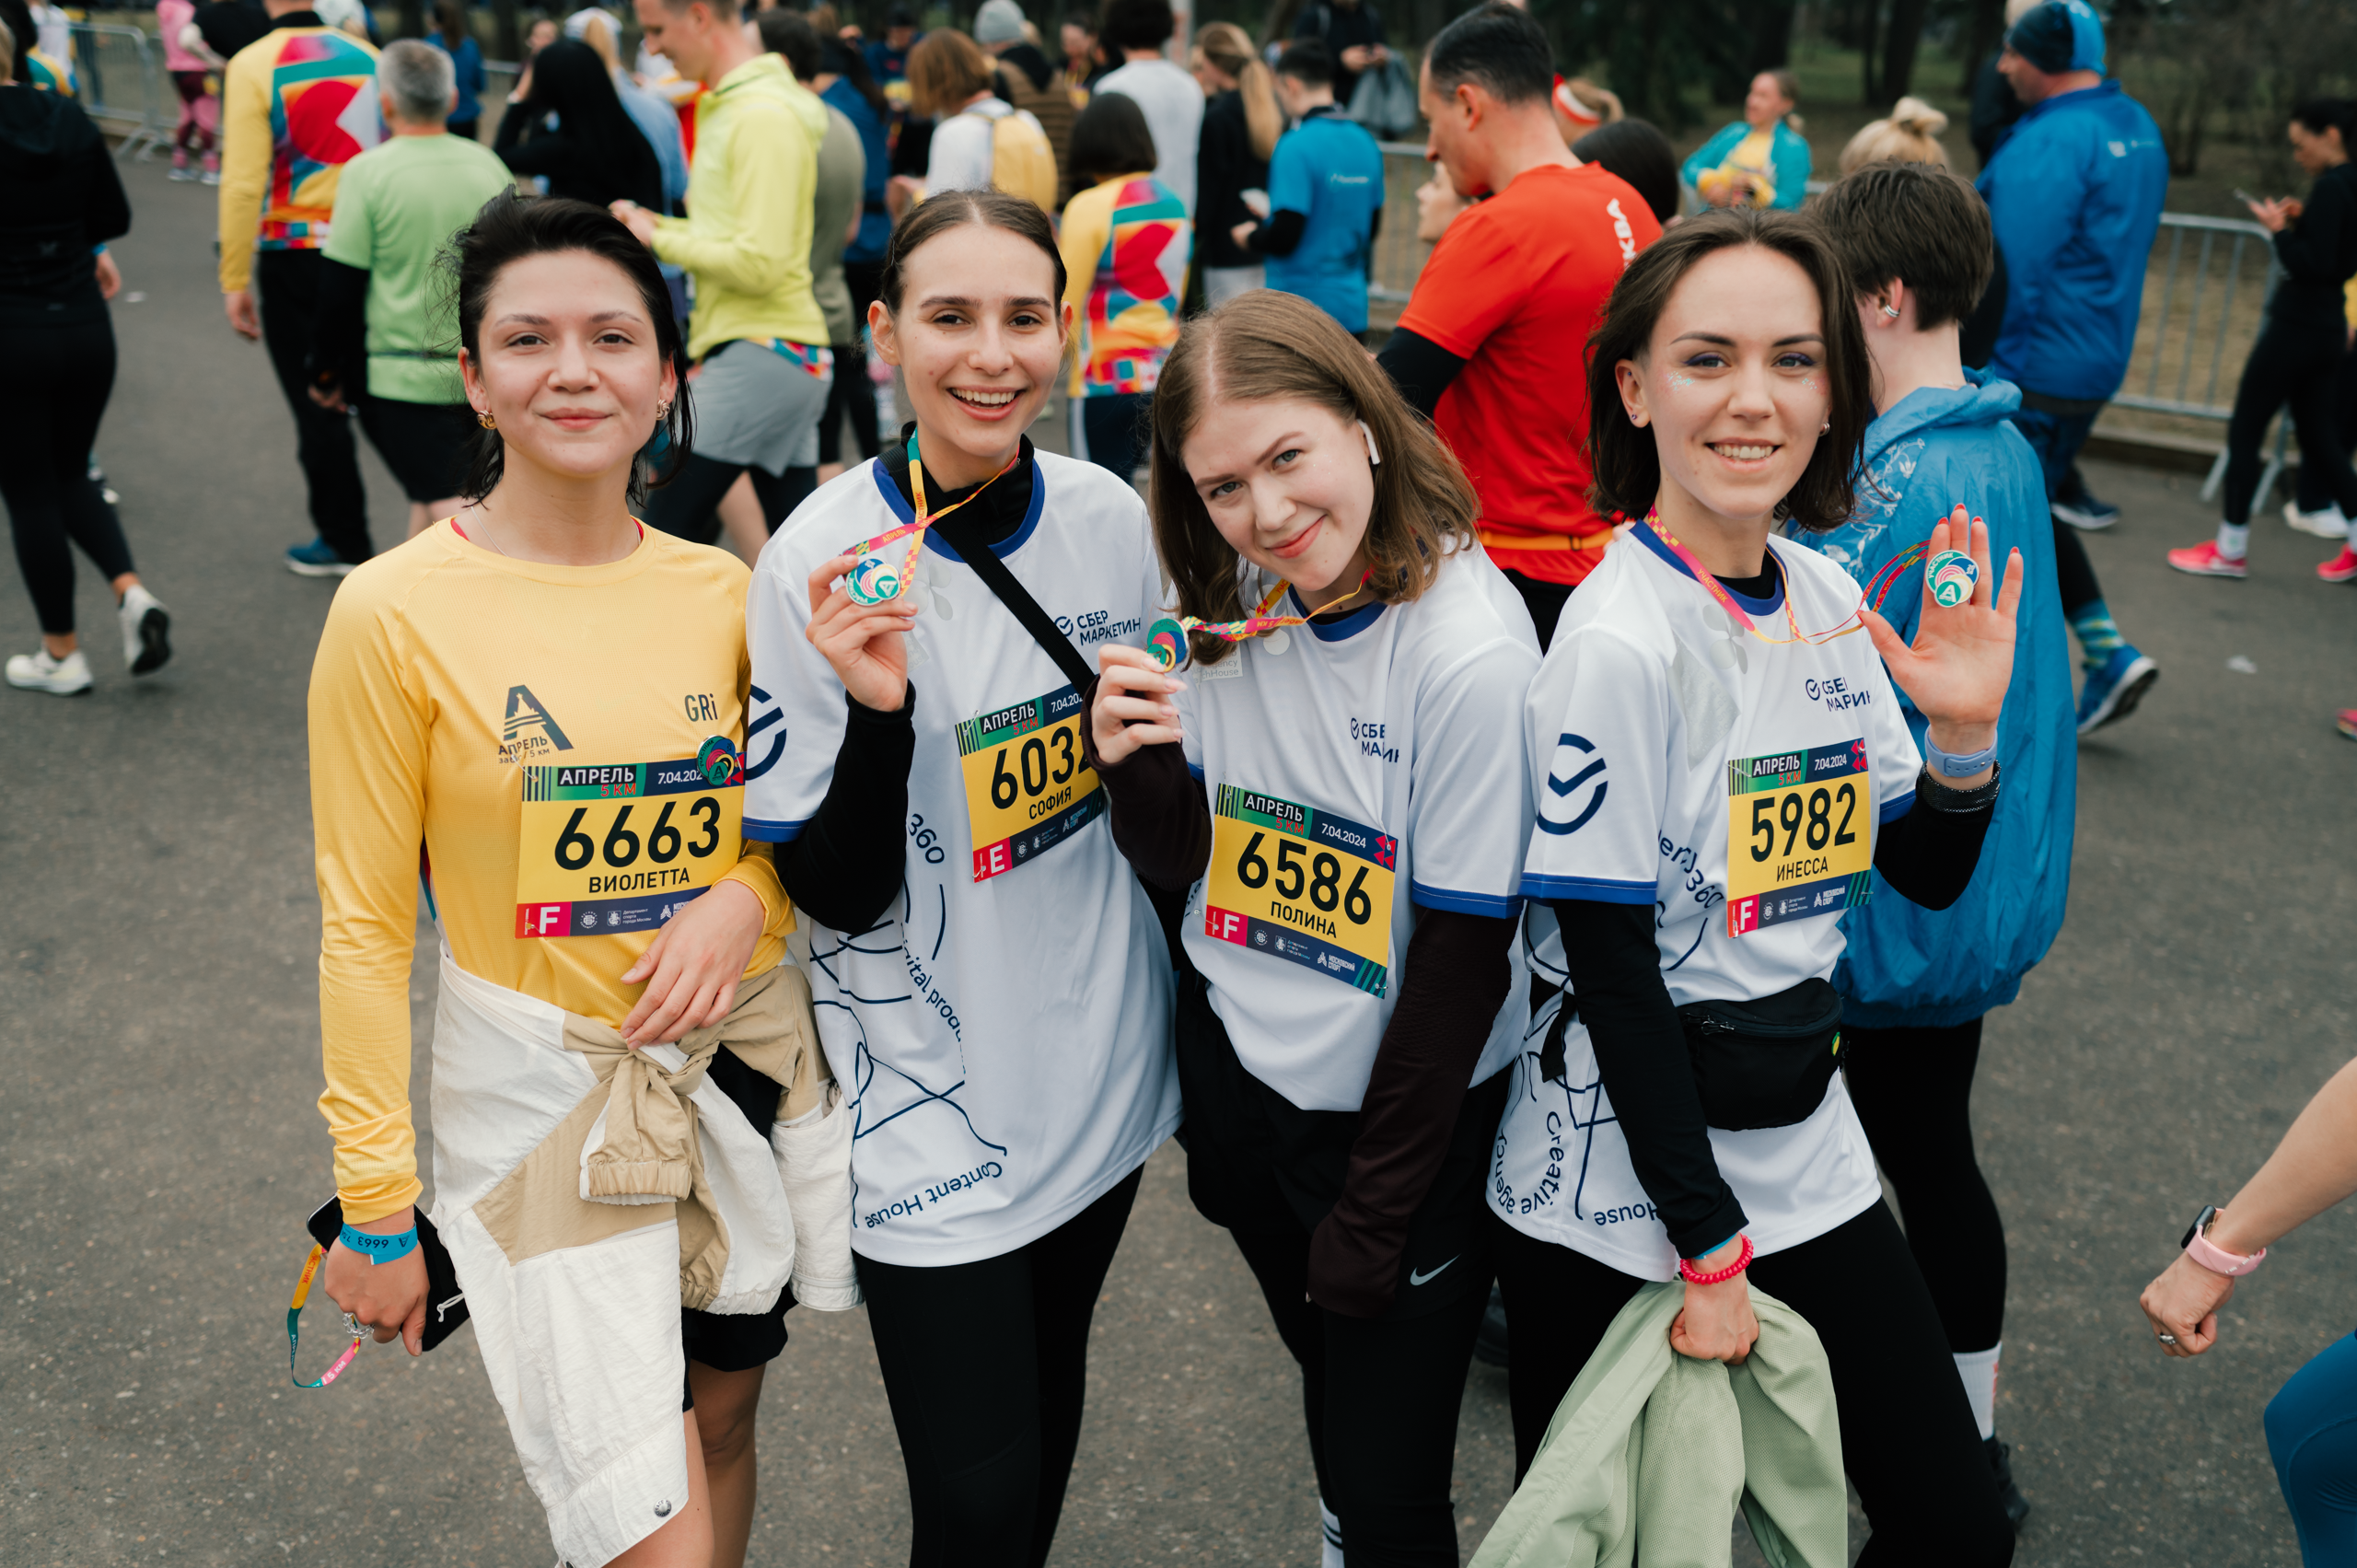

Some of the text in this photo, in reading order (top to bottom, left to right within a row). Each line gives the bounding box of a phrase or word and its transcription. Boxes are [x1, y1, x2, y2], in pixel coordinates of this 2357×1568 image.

[915, 492, 924, 522] АСТНИК
[882, 528, 906, 543] АПРЕЛЬ
[1697, 568, 1728, 603] УЧАСТНИК
[1076, 610, 1109, 629] СБЕР
[1821, 677, 1848, 694] СБЕ
[983, 703, 1036, 733] АПРЕЛЬ
[1013, 716, 1039, 736] 5 КМ
[1361, 723, 1385, 738] СБЕ
[498, 736, 548, 755] АПРЕЛЬ
[529, 749, 535, 758] 5
[538, 748, 551, 756] км
[1753, 755, 1801, 776] АПРЕЛЬ
[1814, 753, 1848, 772] 7.04.2024
[560, 768, 634, 785] АПРЕЛЬ
[657, 769, 703, 784] 7.04.202
[1778, 771, 1802, 785] 5 КМ
[600, 783, 637, 797] 5 КМ
[1028, 785, 1072, 819] СОФИЯ
[1245, 794, 1303, 822] АПРЕЛЬ
[554, 796, 721, 871] 6663
[1275, 817, 1305, 836] 5 КМ
[1321, 823, 1367, 849] 7.04.2024
[1750, 783, 1856, 863] 5982
[989, 844, 1005, 874] E
[1776, 856, 1829, 883] ИНЕССА
[588, 867, 691, 893] ВИОЛЕТТА
[1237, 831, 1372, 925] 6586
[539, 906, 561, 935] F
[1223, 912, 1240, 939] F
[1271, 900, 1337, 938] ПОЛИНА
[1740, 900, 1753, 931] F
[1494, 1110, 1564, 1214] Creative agency
[865, 1161, 1003, 1228] Content House
[1594, 1202, 1658, 1225] House
[357, 1236, 389, 1249] 6663
[327, 1371, 335, 1379] 5
[333, 1360, 346, 1374] КМ
